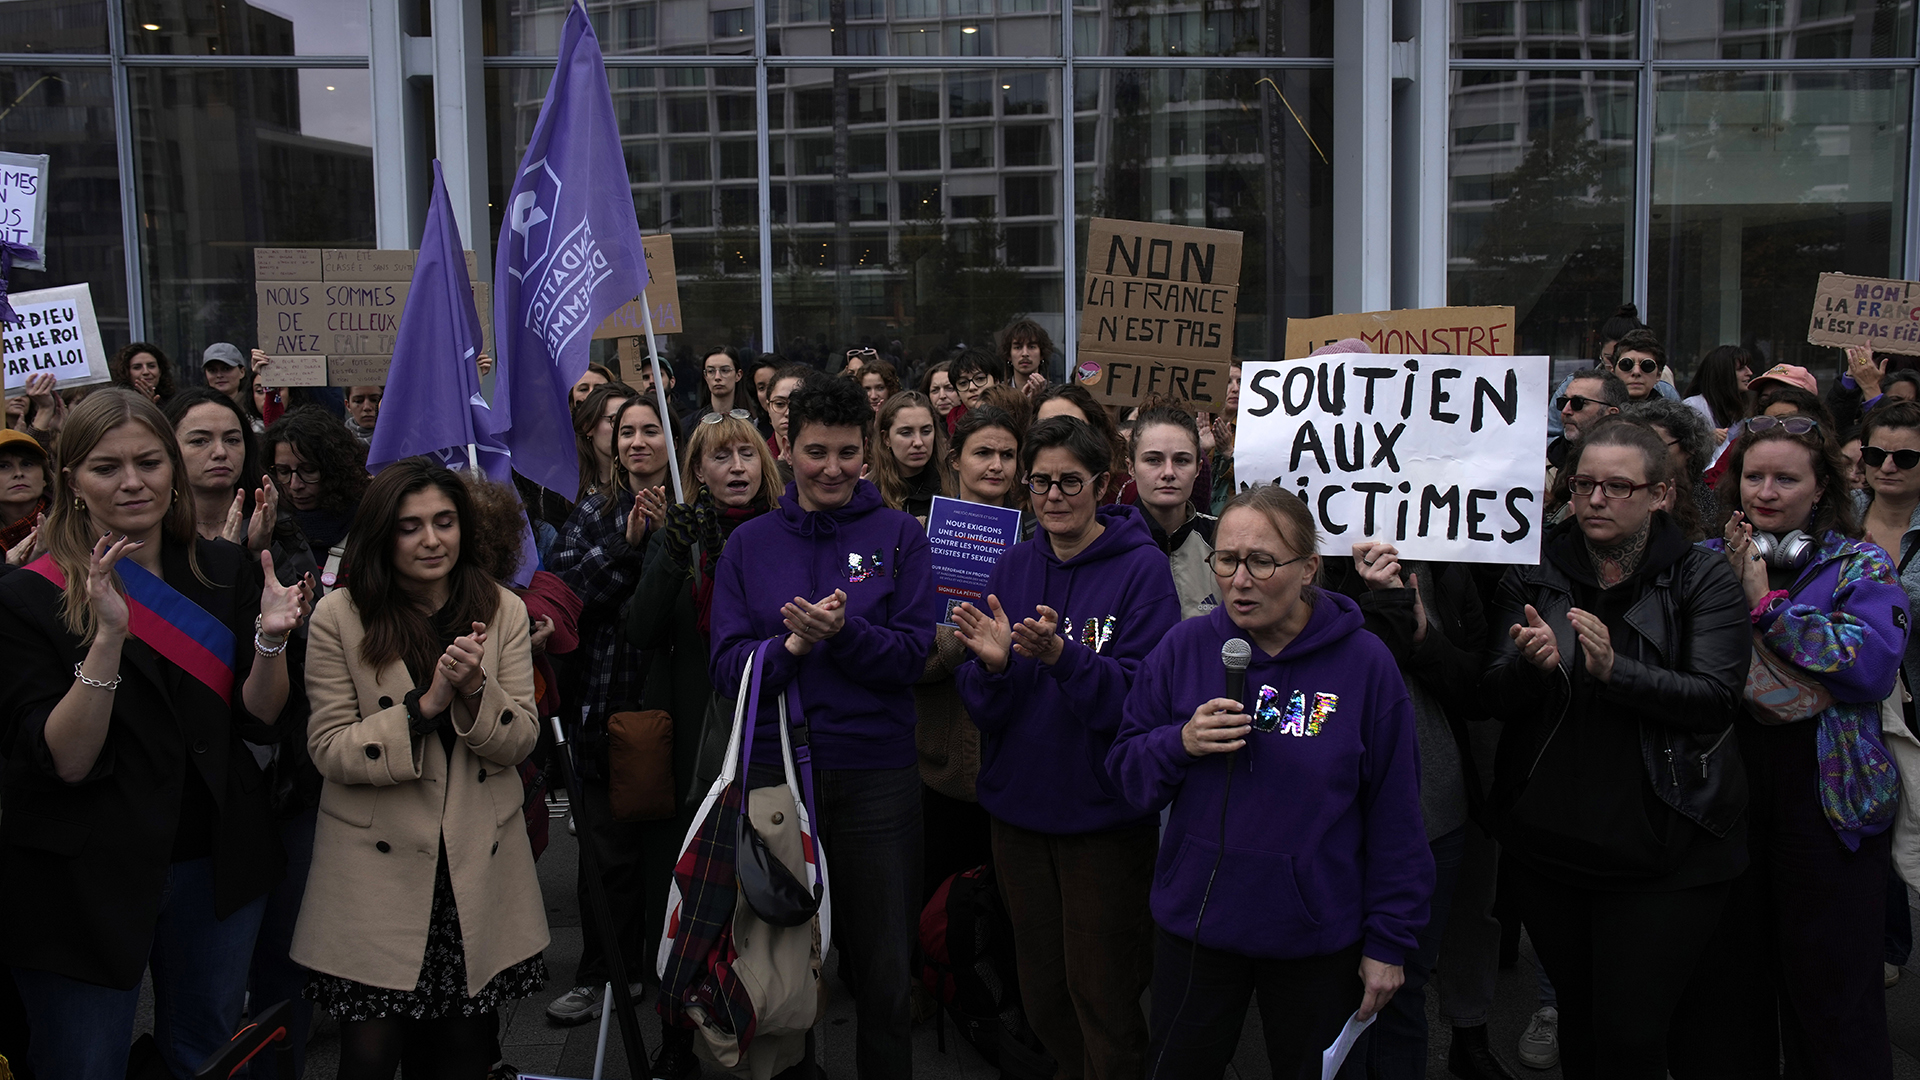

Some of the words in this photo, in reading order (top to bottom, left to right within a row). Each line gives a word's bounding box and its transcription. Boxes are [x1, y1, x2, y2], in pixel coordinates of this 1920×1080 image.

[1105, 234, 1216, 285] NON
[267, 286, 309, 306] NOUS
[326, 285, 396, 307] SOMMES
[1087, 277, 1115, 308] LA
[1122, 281, 1229, 315] FRANCE
[1826, 297, 1848, 314] LA
[29, 307, 75, 327] DIEU
[278, 311, 303, 332] DE
[327, 312, 397, 331] CELLEUX
[1813, 313, 1854, 334] N'EST
[1858, 321, 1888, 338] PAS
[1893, 321, 1920, 342] FiÈ
[28, 331, 48, 349] LE
[50, 326, 79, 345] ROI
[1098, 314, 1170, 344] N'EST
[1173, 318, 1222, 349] PAS
[1360, 323, 1508, 356] MONSTRE
[275, 334, 320, 354] AVEZ
[33, 353, 56, 370] LA
[58, 349, 84, 366] LOI
[1288, 420, 1407, 475] AUX
[938, 527, 954, 537] UNE
[954, 530, 967, 539] LOI
[967, 532, 1006, 546] INTÉGRALE
[945, 519, 967, 529] NOUS
[967, 522, 1003, 535] EXIGEONS
[930, 536, 959, 548] CONTRE
[959, 541, 972, 550] LES
[930, 546, 961, 558] SEXISTES
[961, 552, 971, 560] ET
[970, 553, 998, 564] SEXUEL
[938, 586, 956, 594] SIGNEZ
[1252, 684, 1340, 738] BAF
